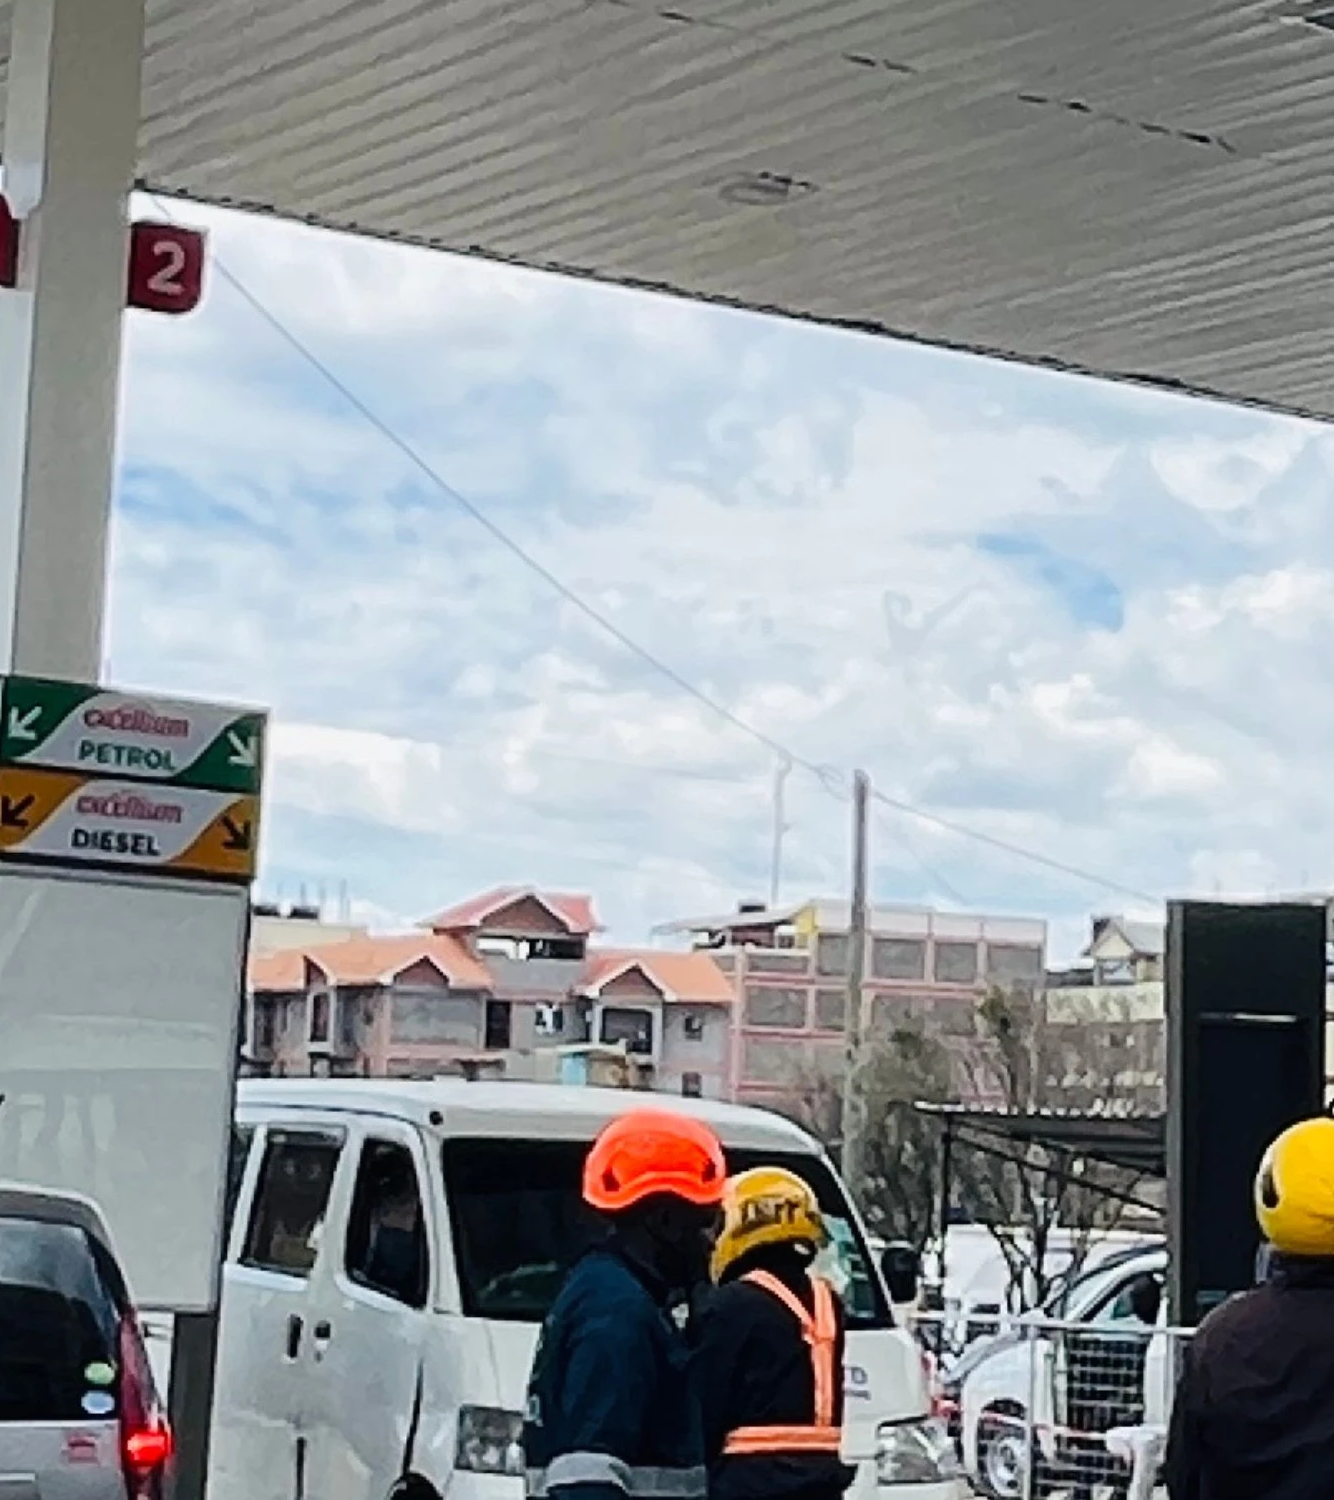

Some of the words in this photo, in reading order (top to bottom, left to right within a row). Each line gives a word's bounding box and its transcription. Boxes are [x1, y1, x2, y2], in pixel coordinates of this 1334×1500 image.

[147, 241, 186, 295] 2
[78, 739, 177, 771] PETROL
[71, 828, 160, 856] DIESEL
